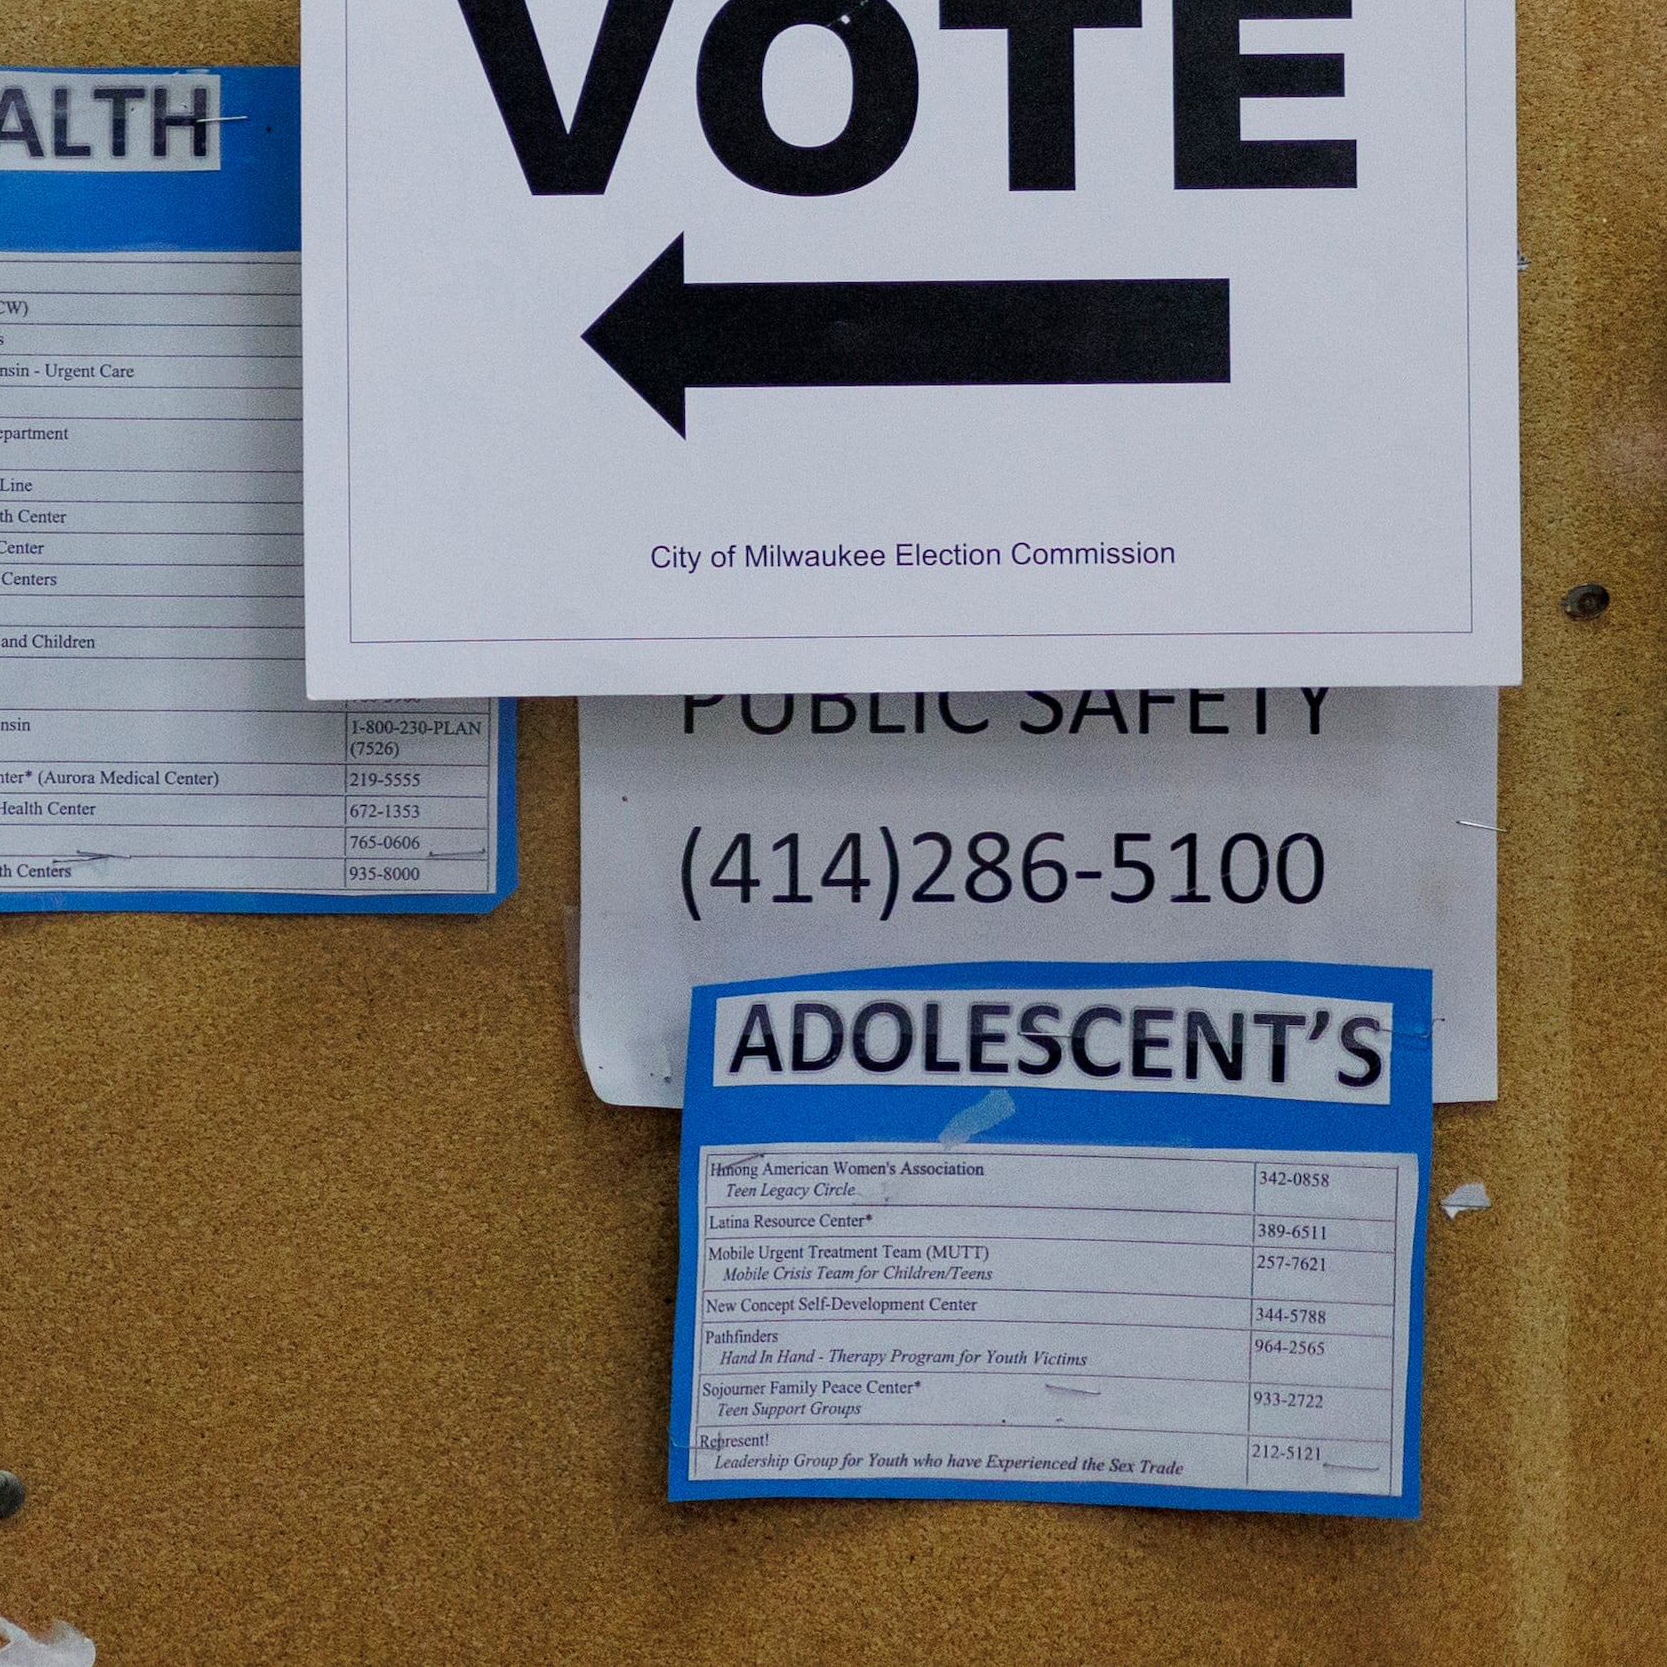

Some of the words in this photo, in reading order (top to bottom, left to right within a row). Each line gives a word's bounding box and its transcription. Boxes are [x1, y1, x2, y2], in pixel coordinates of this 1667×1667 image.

[650, 544, 702, 575] City
[710, 544, 737, 569] of
[744, 543, 886, 568] Milwaukee
[895, 542, 1001, 567] Election
[1010, 541, 1176, 566] Commission
[352, 719, 482, 736] 1-800-230-PLAN
[349, 770, 423, 791] 219-5555
[681, 826, 1325, 922] (414)286-5100
[729, 1001, 1383, 1090] ADOLESCENT'S
[707, 1213, 751, 1231] Latina
[753, 1214, 816, 1229] Resource
[1256, 1223, 1329, 1243] 389-6511
[707, 1244, 757, 1262] Mobile
[758, 1245, 804, 1264] Urgent
[808, 1244, 878, 1260] Treatment
[882, 1244, 922, 1259] Team
[925, 1244, 990, 1262] (MUTT)
[1256, 1254, 1327, 1275] 257-7621
[704, 1328, 780, 1346] Pathfinders
